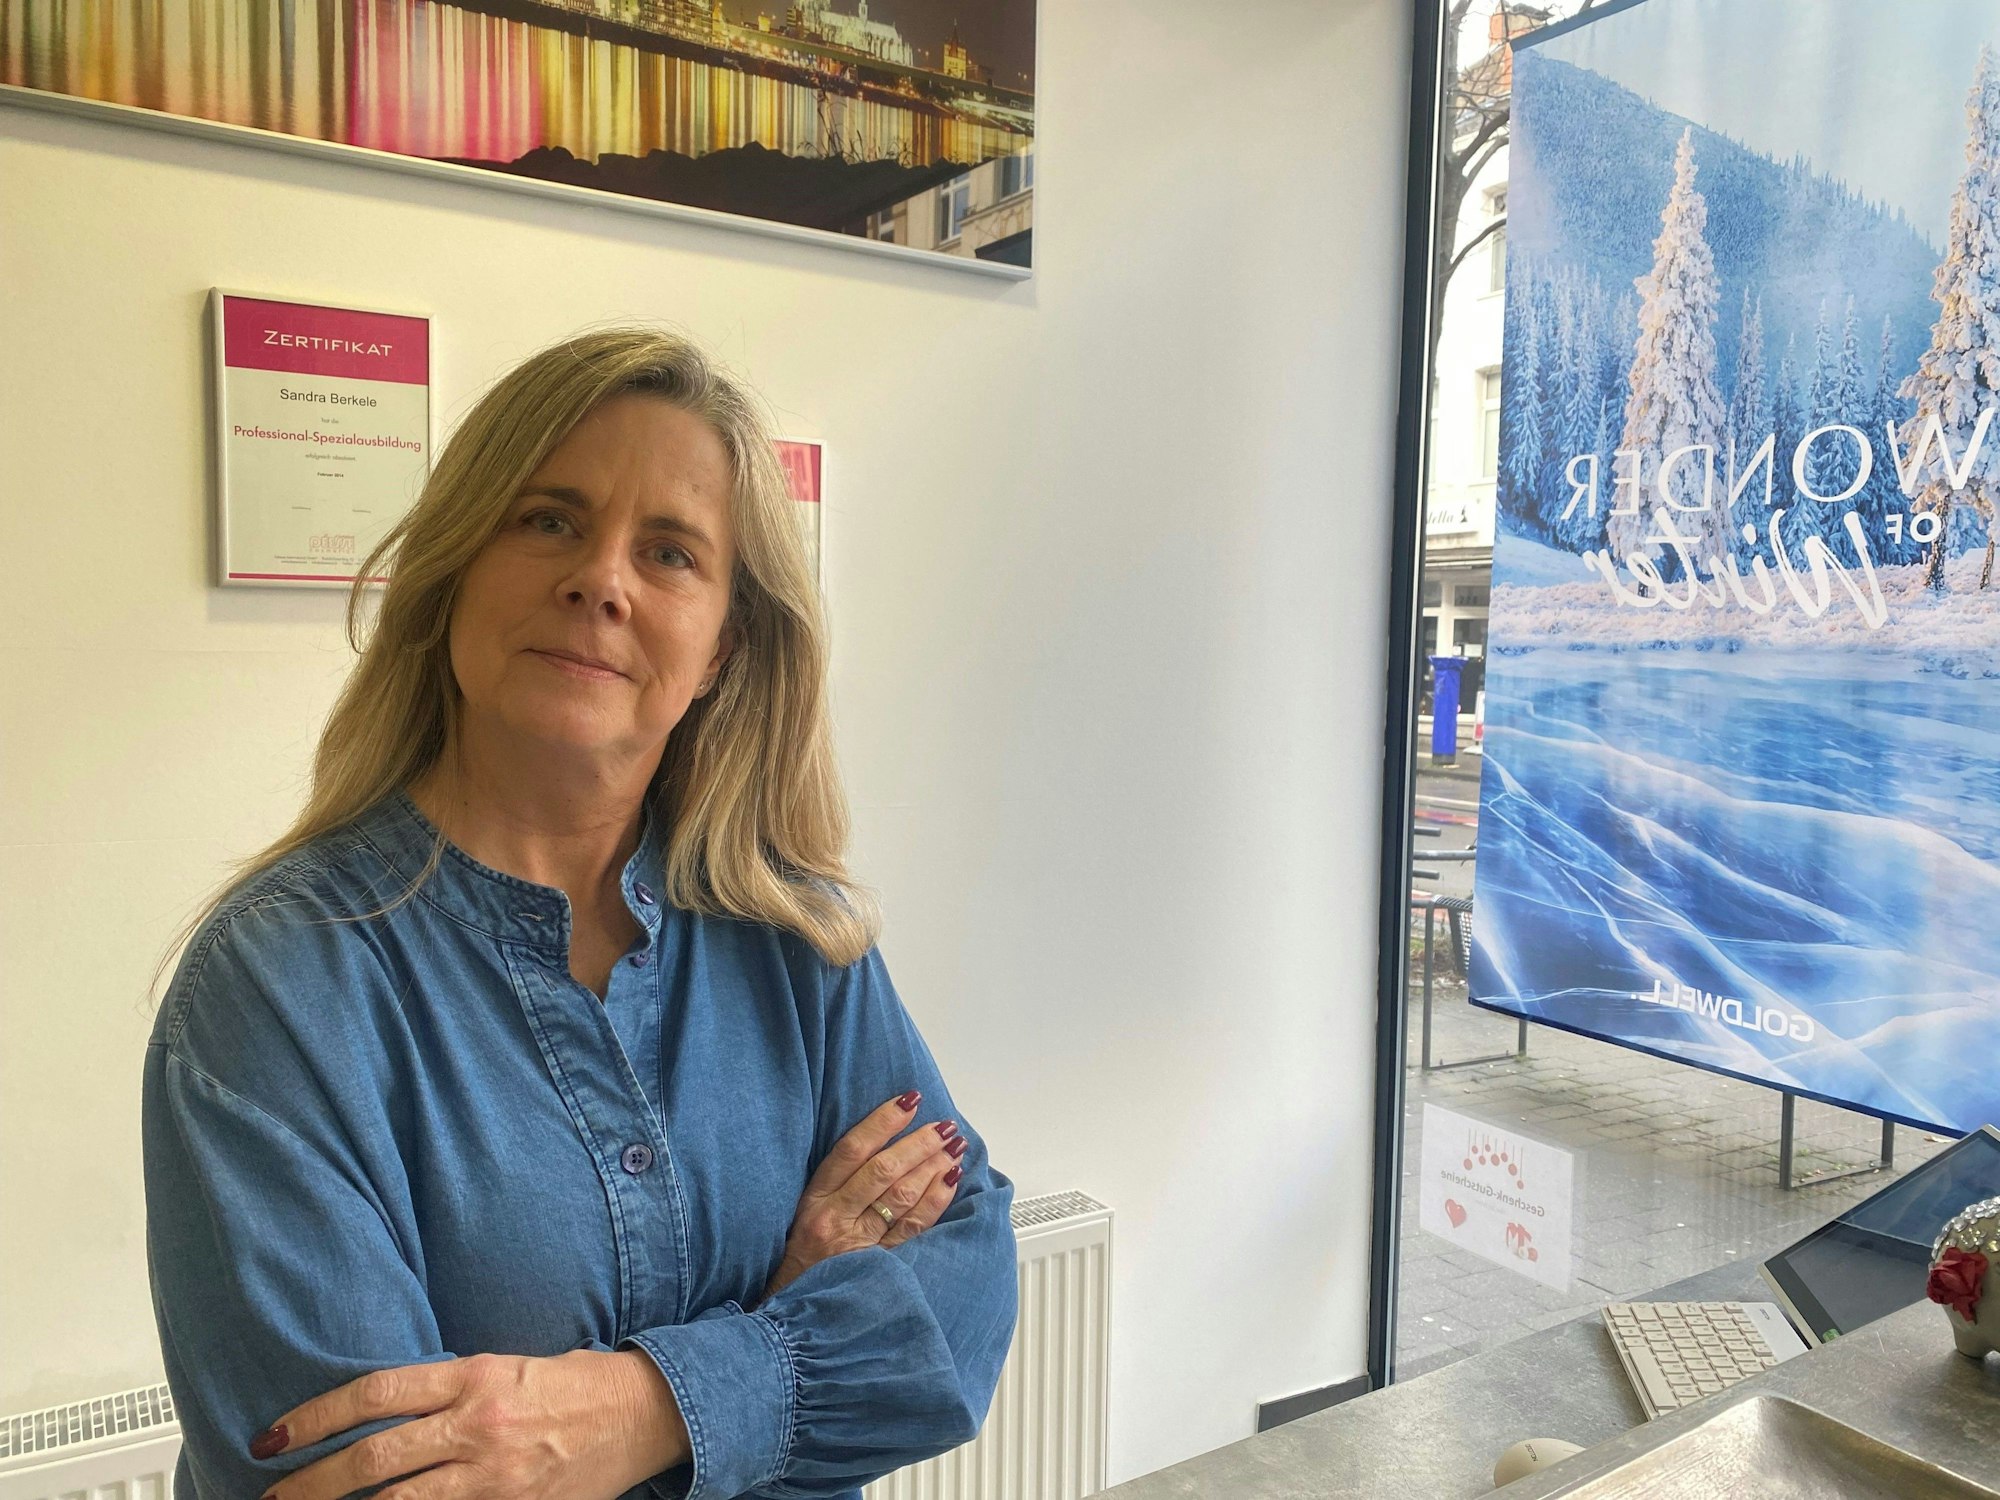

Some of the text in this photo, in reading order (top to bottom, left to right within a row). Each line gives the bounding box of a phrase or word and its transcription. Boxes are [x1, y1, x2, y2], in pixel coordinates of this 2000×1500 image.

[263, 329, 393, 357] ZERTIFIKAT
[280, 388, 377, 408] Sandra Berkele
[234, 425, 422, 453] Professional-Spezialausbildung
